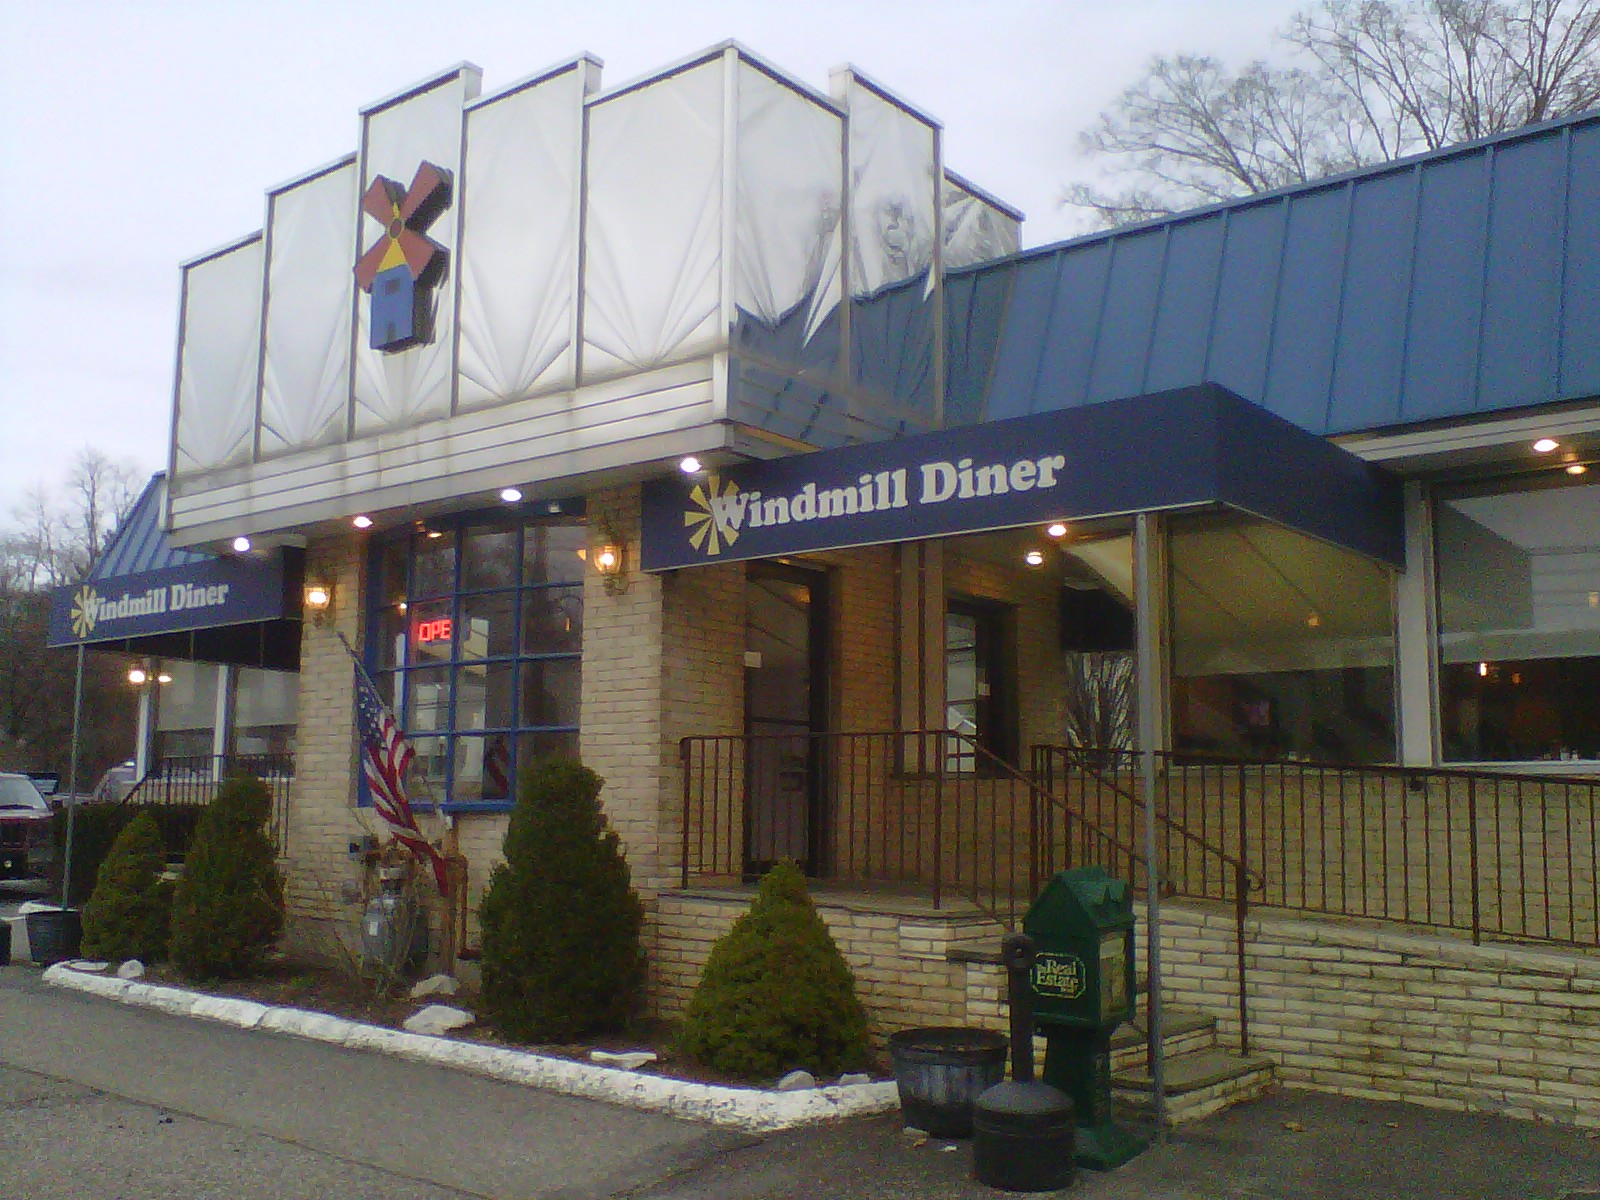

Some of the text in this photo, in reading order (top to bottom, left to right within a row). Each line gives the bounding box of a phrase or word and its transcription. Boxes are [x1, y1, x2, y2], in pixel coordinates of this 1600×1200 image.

[711, 455, 1066, 531] Windmill Diner
[84, 583, 229, 622] Windmill Diner
[418, 619, 452, 641] OPE
[1046, 959, 1077, 975] Real
[1036, 971, 1079, 987] Estate
